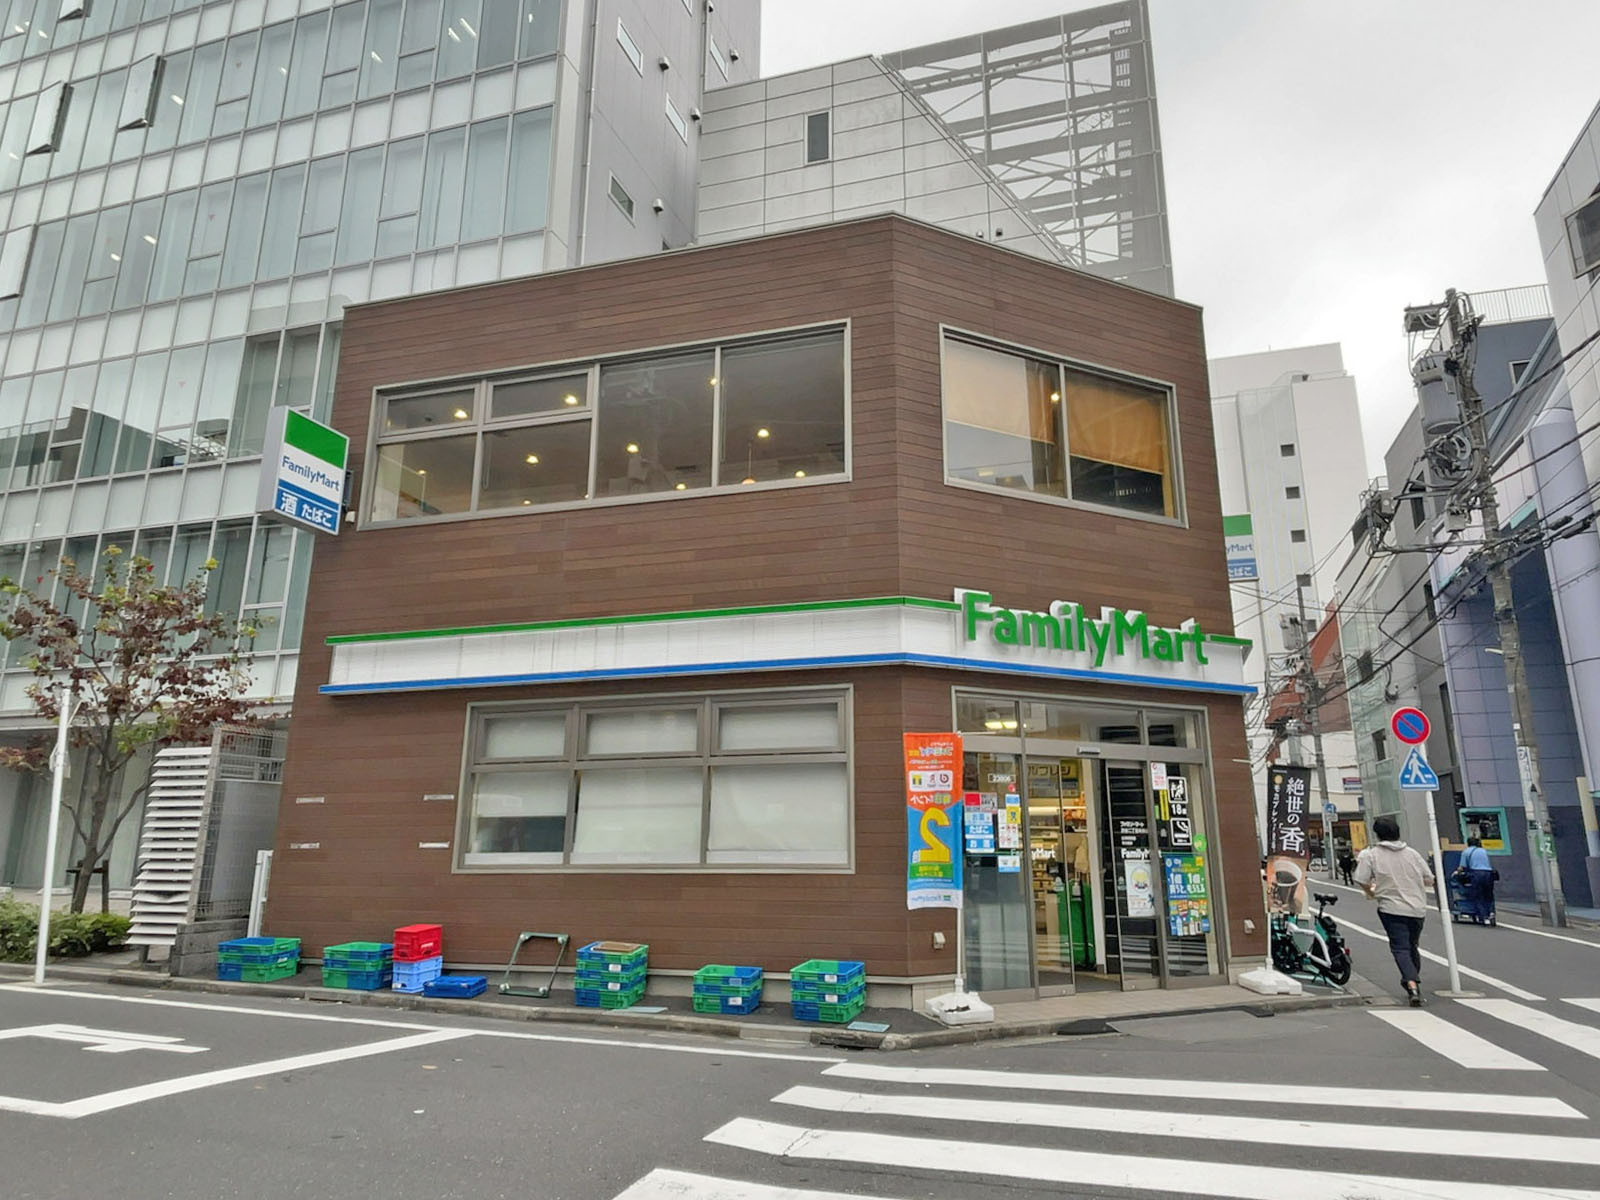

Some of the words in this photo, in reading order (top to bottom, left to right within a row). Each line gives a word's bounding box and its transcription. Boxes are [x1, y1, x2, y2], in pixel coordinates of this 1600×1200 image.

[281, 456, 340, 491] FamilyMart
[280, 493, 298, 516] 酒
[301, 503, 333, 528] たばこ
[961, 590, 1209, 668] FamilyMart
